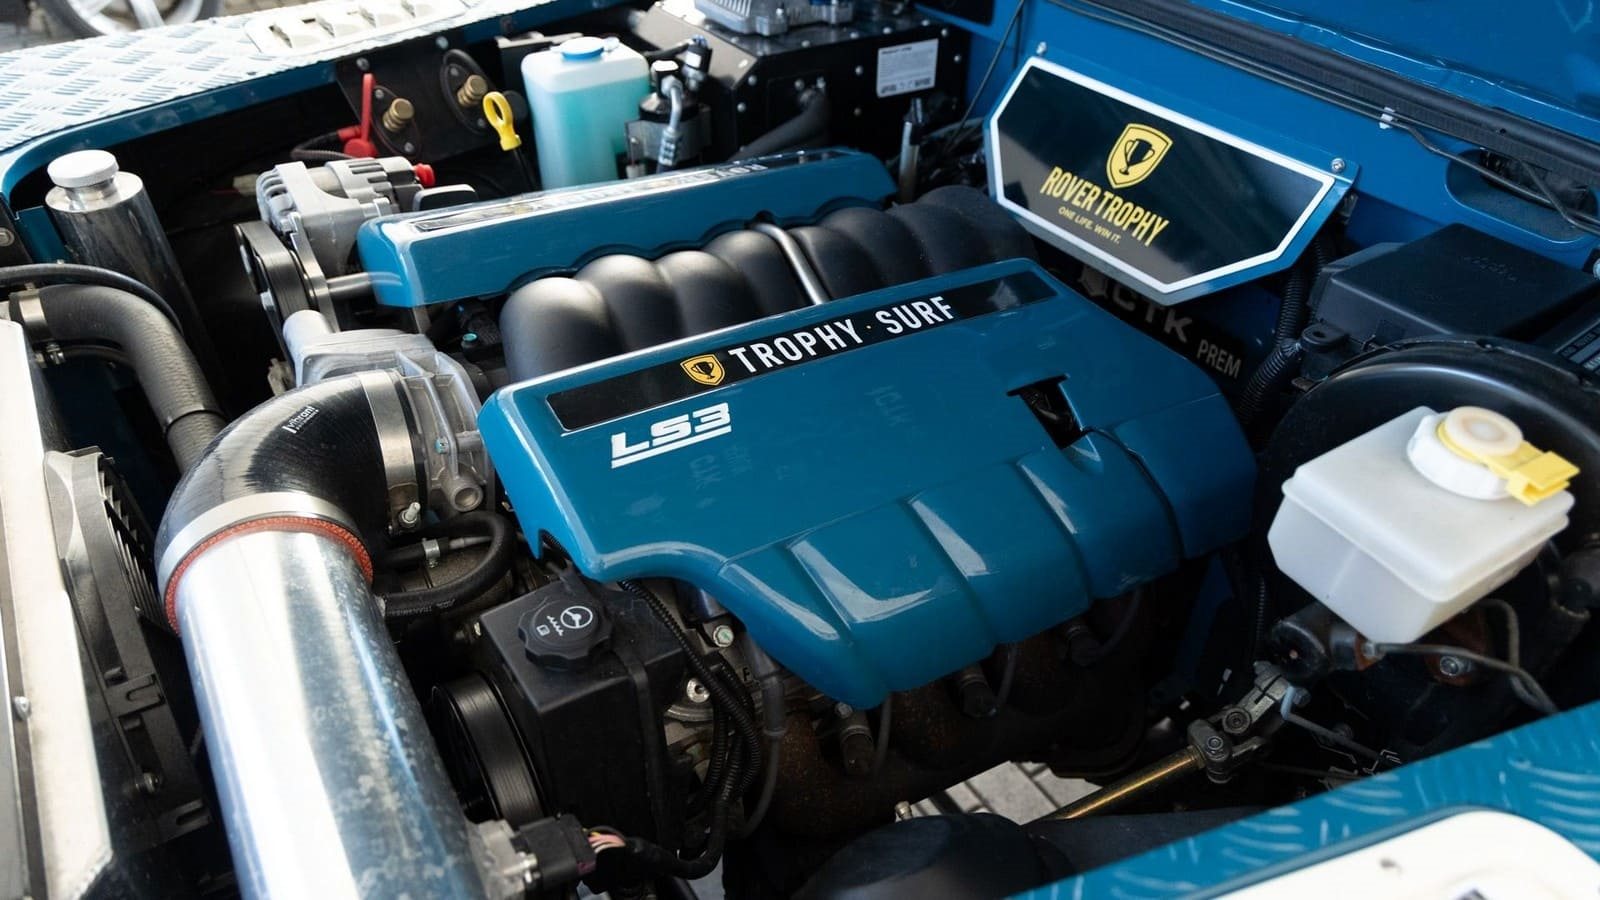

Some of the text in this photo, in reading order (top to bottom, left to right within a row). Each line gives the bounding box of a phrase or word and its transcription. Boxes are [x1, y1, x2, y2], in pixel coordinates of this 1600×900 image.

[1040, 166, 1170, 248] ROVER TROPHY
[1058, 206, 1076, 220] ONE
[1074, 214, 1095, 230] LIFE.
[1094, 223, 1112, 239] WIN
[728, 296, 955, 374] TROPHY SURF
[1197, 339, 1241, 379] PREM
[611, 402, 731, 460] LS3
